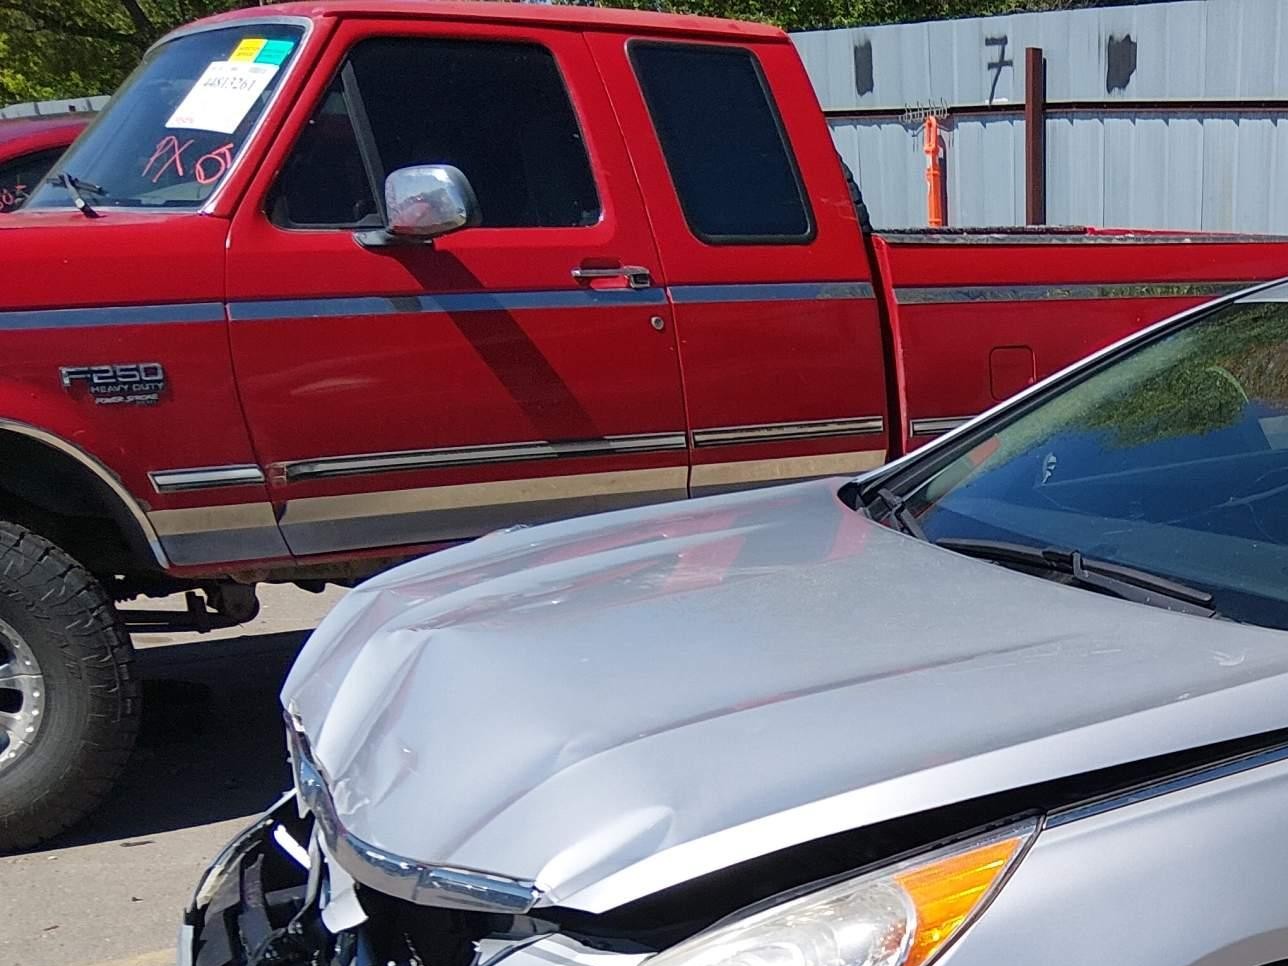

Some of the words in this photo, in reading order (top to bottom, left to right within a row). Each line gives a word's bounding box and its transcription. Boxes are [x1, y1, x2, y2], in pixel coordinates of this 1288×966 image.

[984, 35, 1013, 105] 7
[59, 362, 164, 387] F250
[90, 385, 129, 394] HEAVY
[132, 382, 164, 392] DUTY
